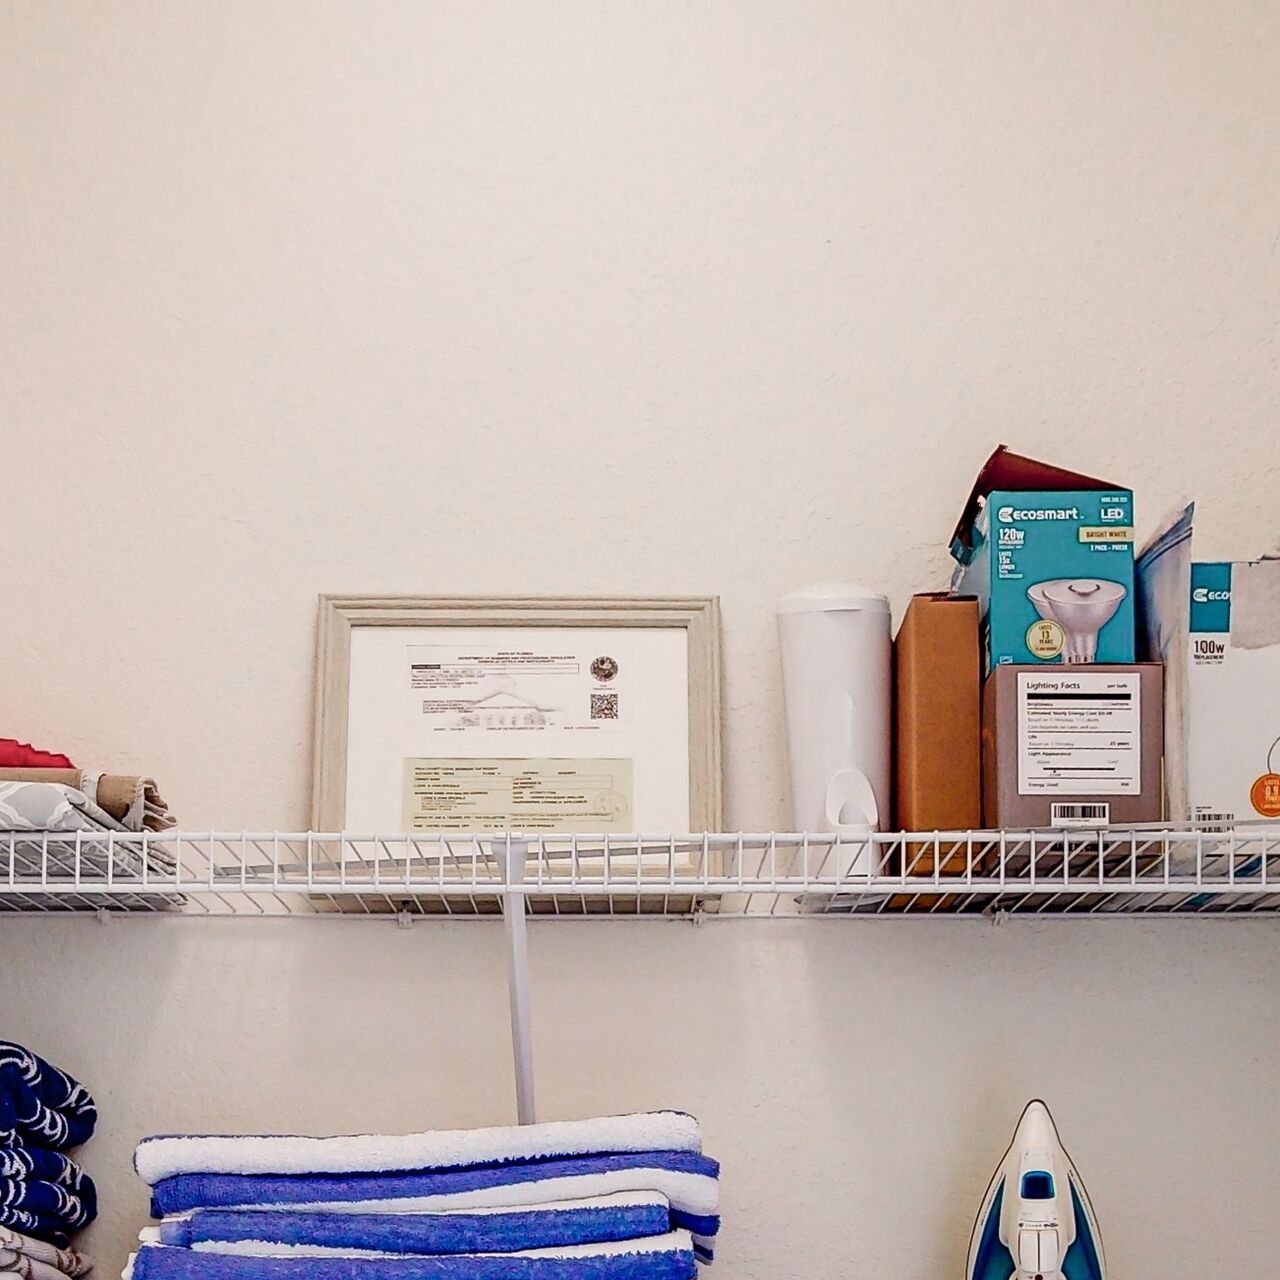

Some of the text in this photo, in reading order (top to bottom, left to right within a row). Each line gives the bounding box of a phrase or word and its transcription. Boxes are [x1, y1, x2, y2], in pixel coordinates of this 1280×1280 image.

[1013, 506, 1078, 520] ecosmart
[1101, 508, 1125, 519] LED
[1208, 590, 1231, 600] eco
[1041, 631, 1050, 640] 13
[1194, 640, 1225, 654] 100w
[1026, 681, 1059, 691] Lighting
[1061, 682, 1080, 690] Facts
